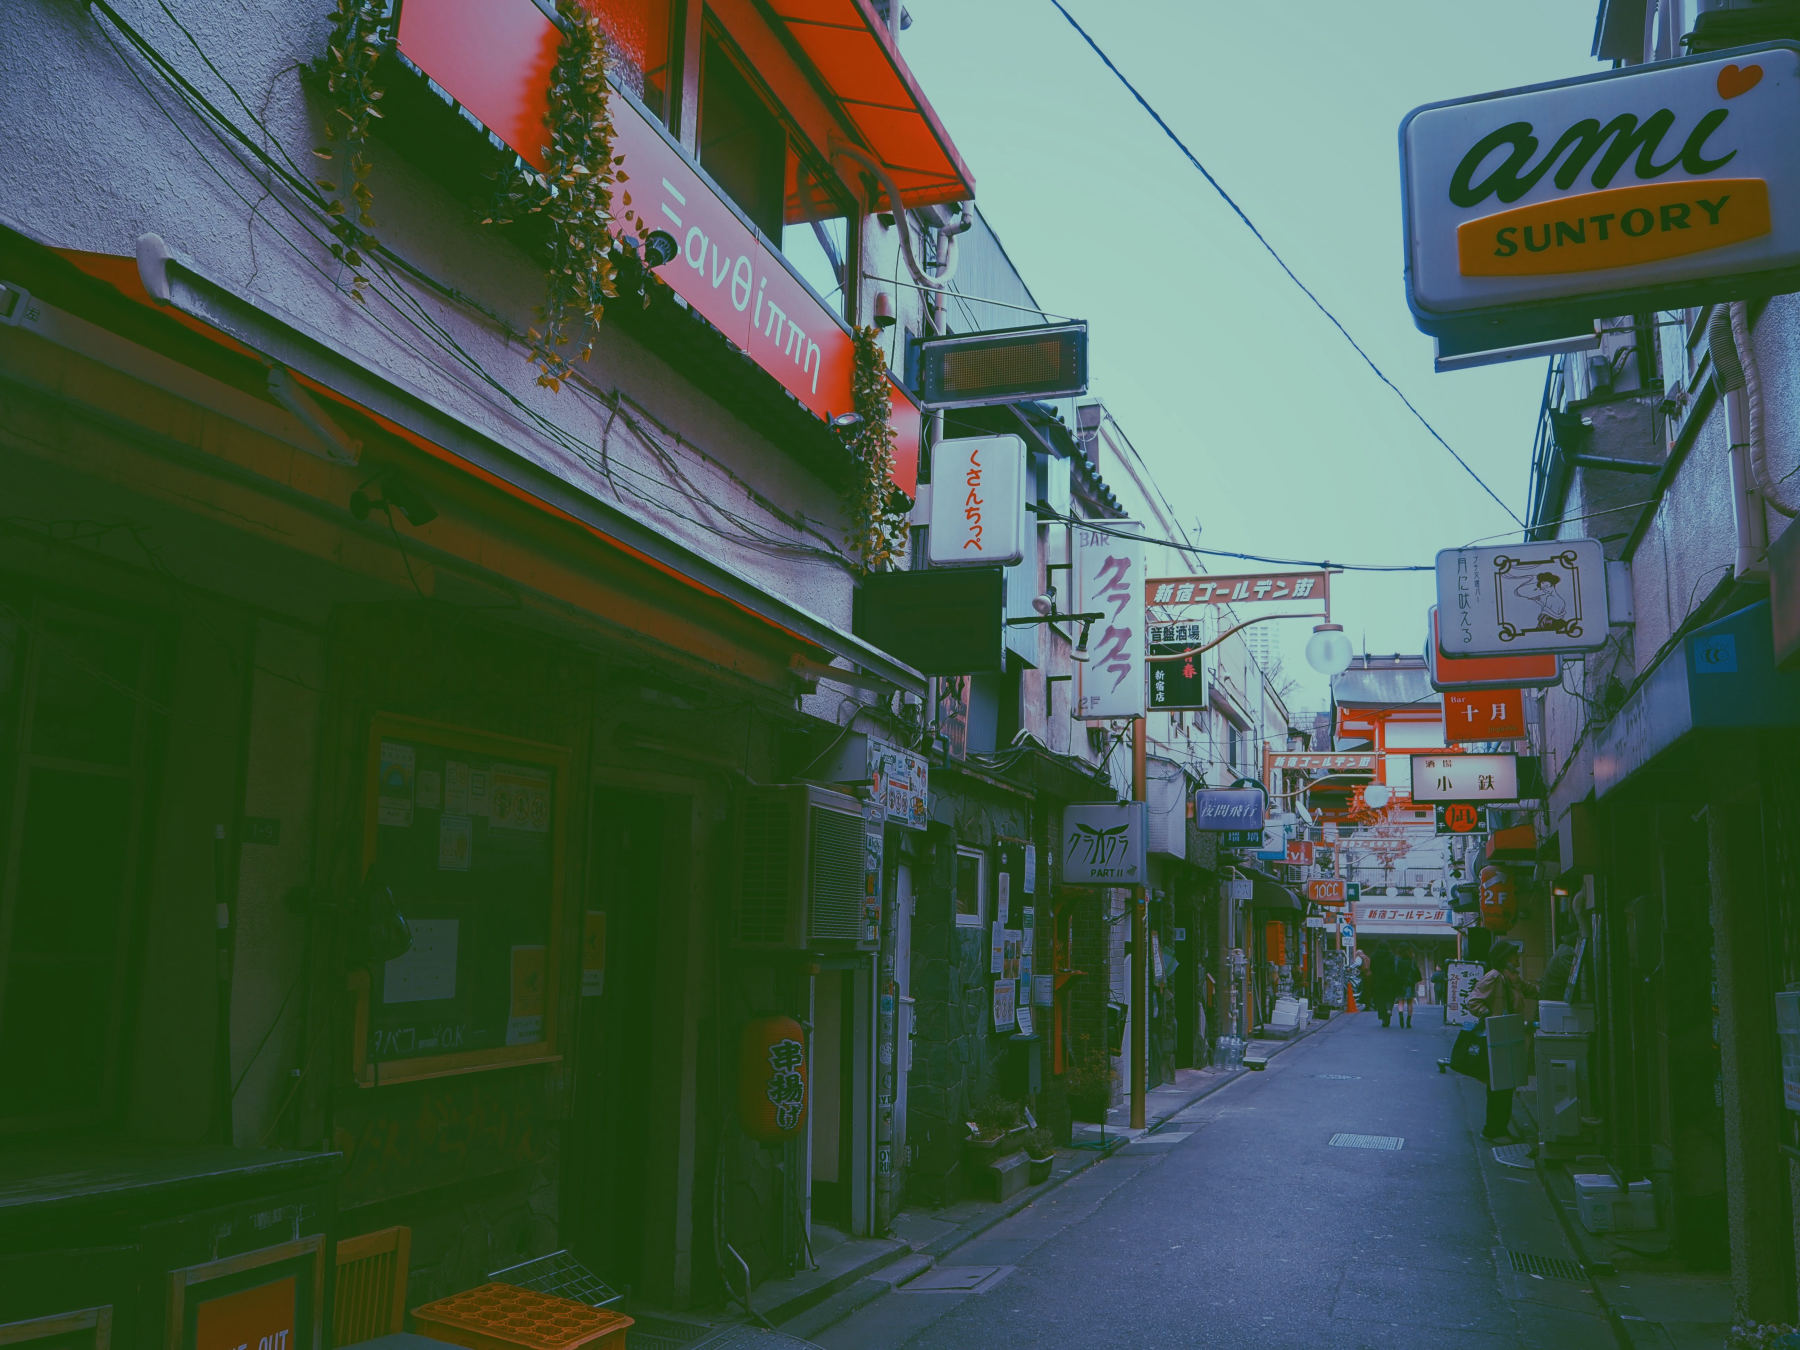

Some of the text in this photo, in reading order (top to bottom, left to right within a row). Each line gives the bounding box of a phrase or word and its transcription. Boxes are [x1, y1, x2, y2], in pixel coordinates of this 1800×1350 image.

[1449, 107, 1738, 208] ami
[1493, 194, 1731, 258] SUNTORY
[1079, 530, 1111, 548] BAR
[1153, 577, 1317, 605] 新宿ゴールデン街
[1456, 556, 1473, 644] 月に吠える
[1091, 554, 1132, 695] クラクラ
[1150, 624, 1202, 643] 音盤酒場
[1155, 669, 1166, 703] 新宿店
[1079, 696, 1101, 710] 2F
[1450, 695, 1467, 704] Bar
[1461, 703, 1507, 722] 十月
[1436, 774, 1495, 792] 小鉄
[1090, 868, 1115, 878] PART
[1485, 890, 1508, 905] 2F
